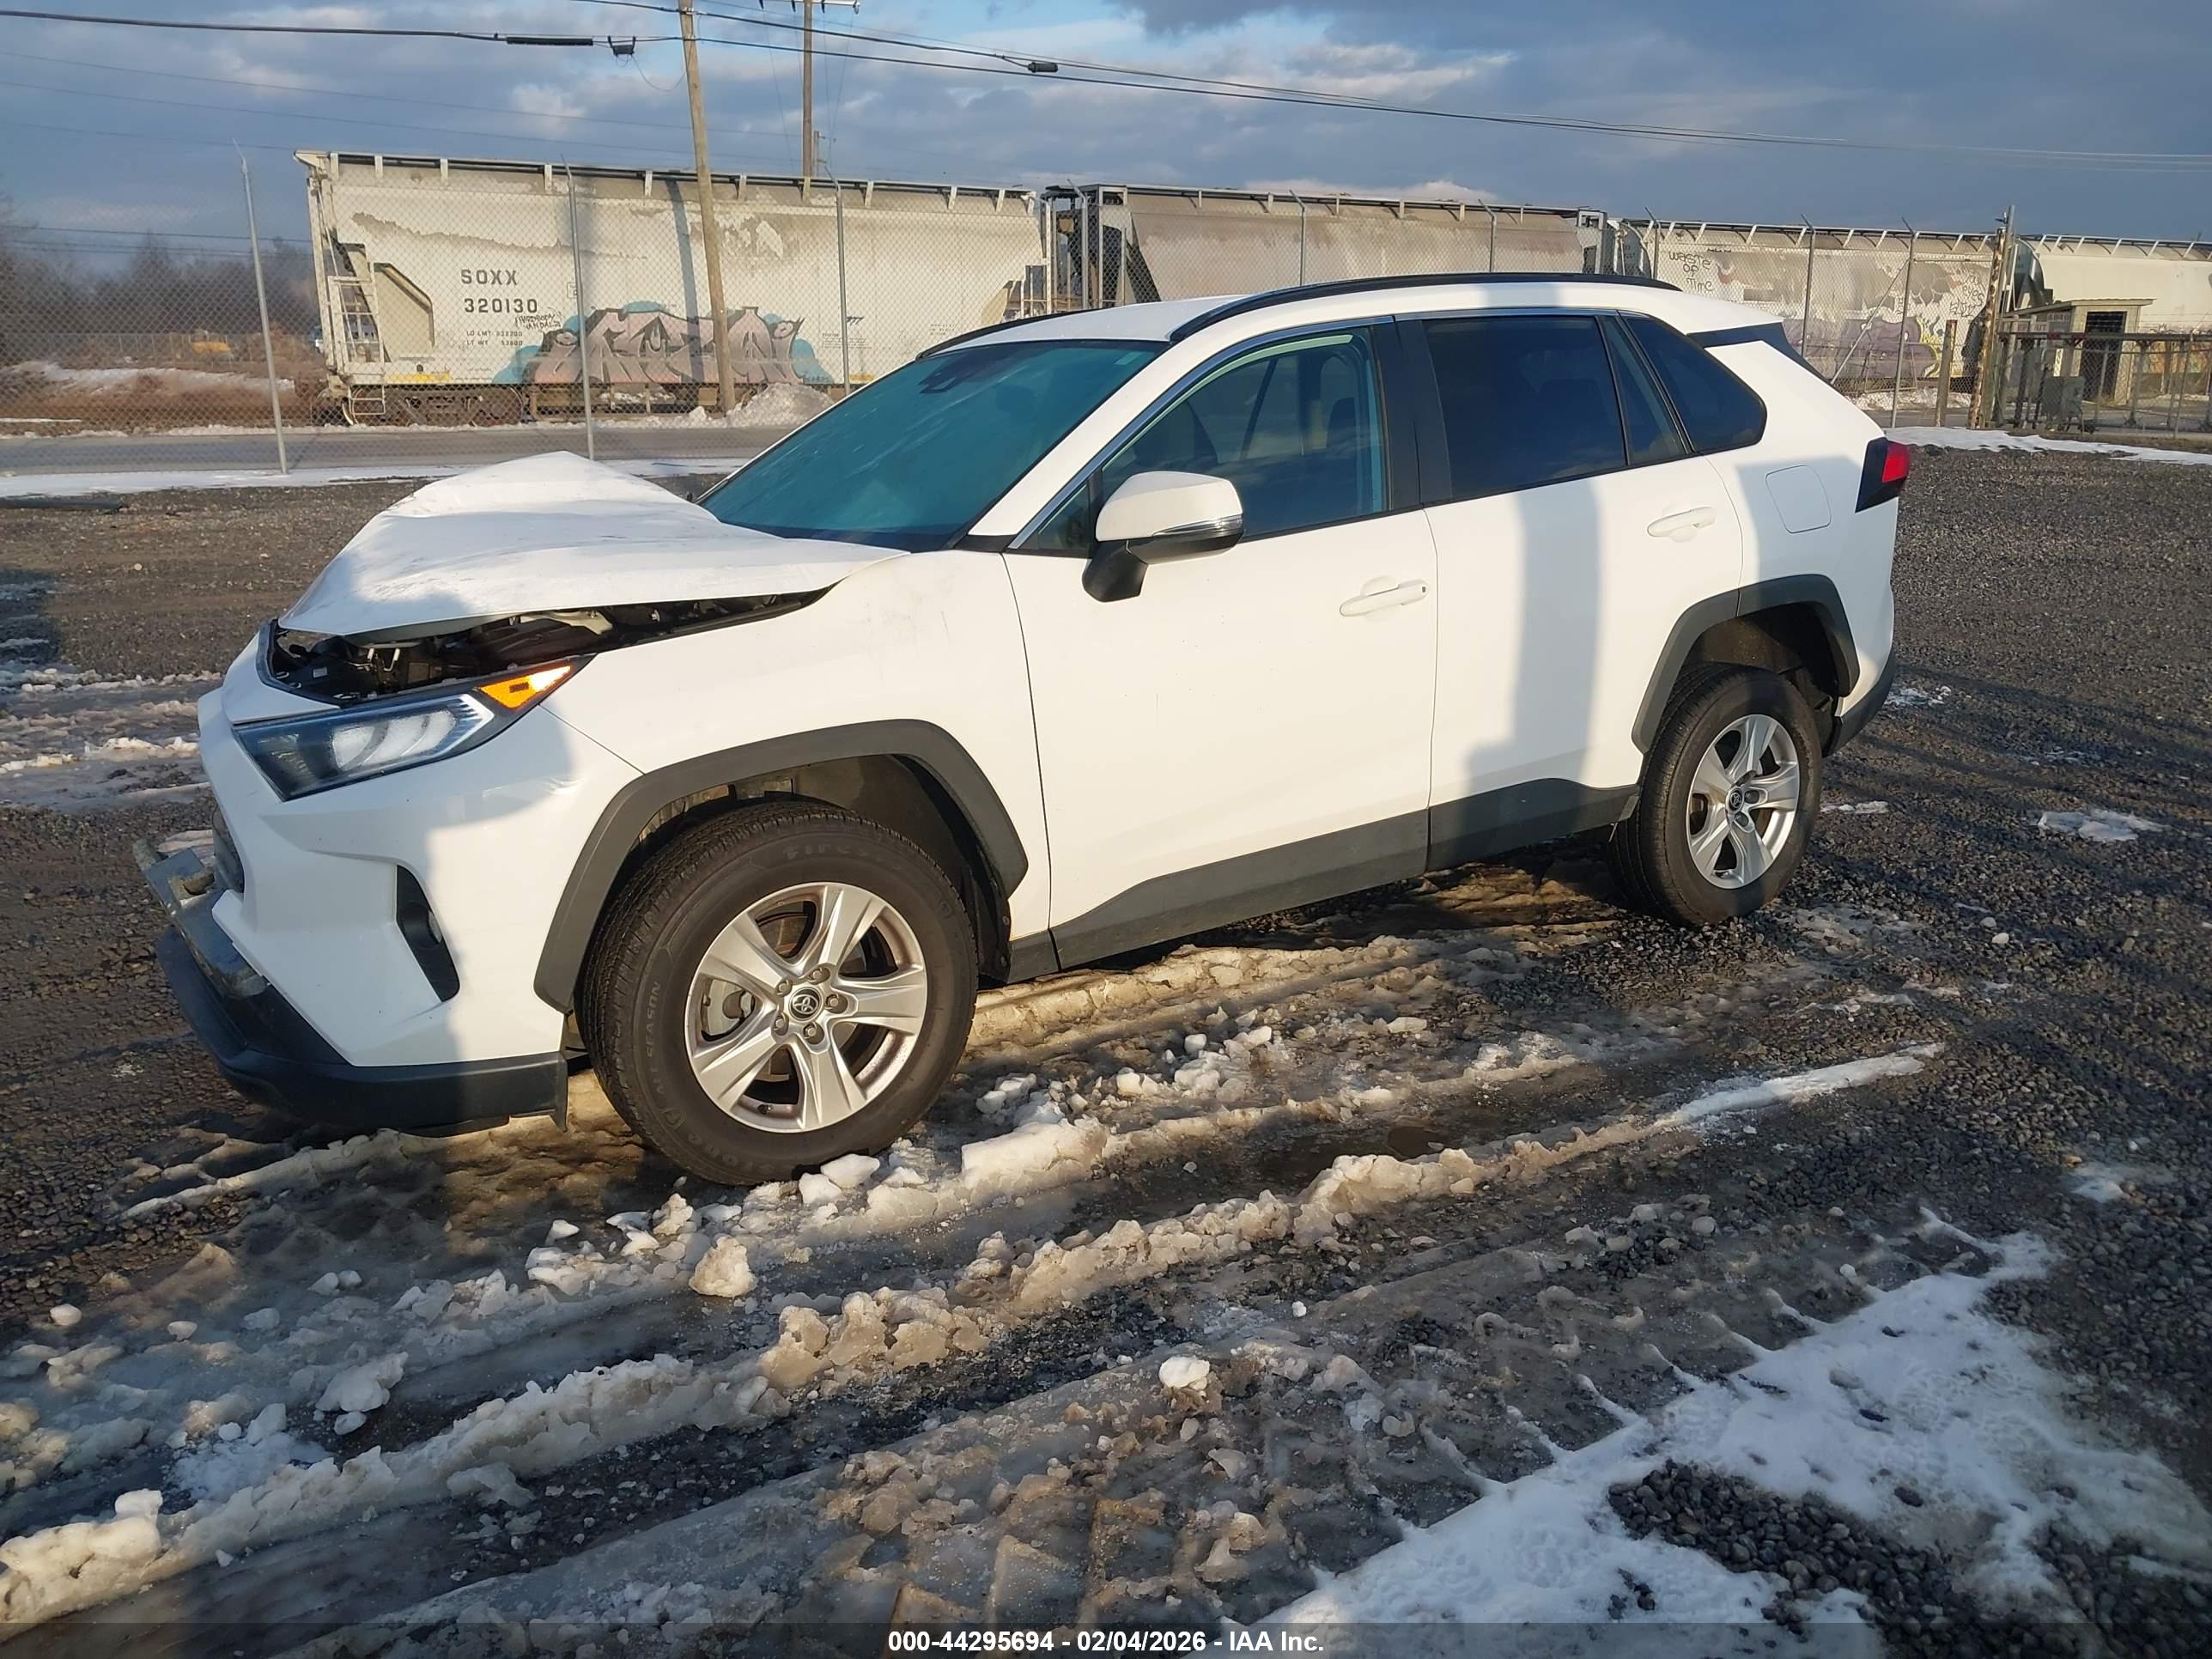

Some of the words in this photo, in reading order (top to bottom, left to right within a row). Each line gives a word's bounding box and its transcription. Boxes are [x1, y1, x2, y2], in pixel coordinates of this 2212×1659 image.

[461, 269, 518, 286] SOXX
[464, 298, 538, 313] 320130
[646, 981, 660, 1058] SEASON
